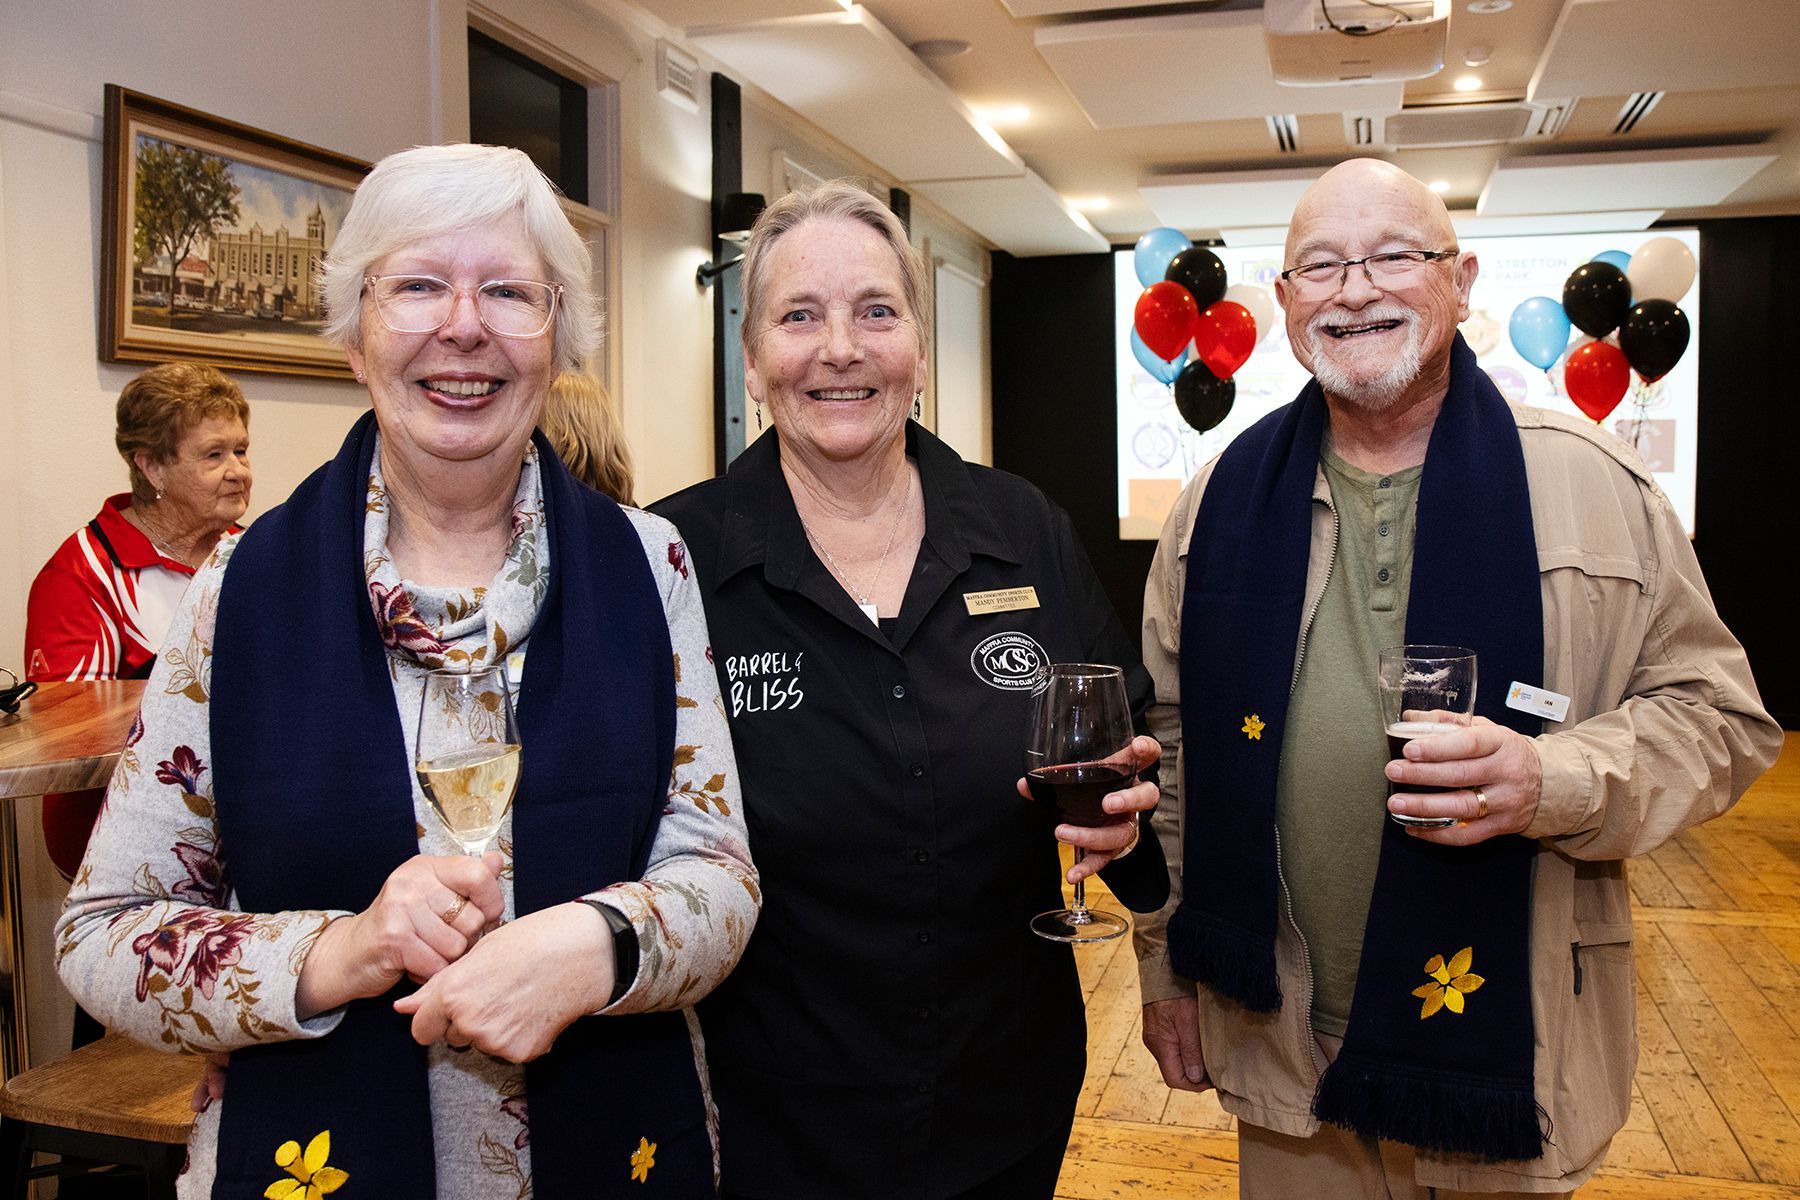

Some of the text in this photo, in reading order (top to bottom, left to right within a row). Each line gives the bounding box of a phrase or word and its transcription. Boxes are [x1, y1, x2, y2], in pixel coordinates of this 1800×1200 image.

[1496, 257, 1568, 270] STRETTON
[1496, 271, 1529, 281] PARK
[975, 595, 1029, 607] MANDY PEMBERTON
[984, 591, 1008, 599] COMMUNITY
[979, 636, 1035, 655] MAFFRA COMMUNITY
[725, 652, 792, 682] BARREL
[993, 676, 1019, 687] SPORTS
[730, 677, 804, 718] BLISS
